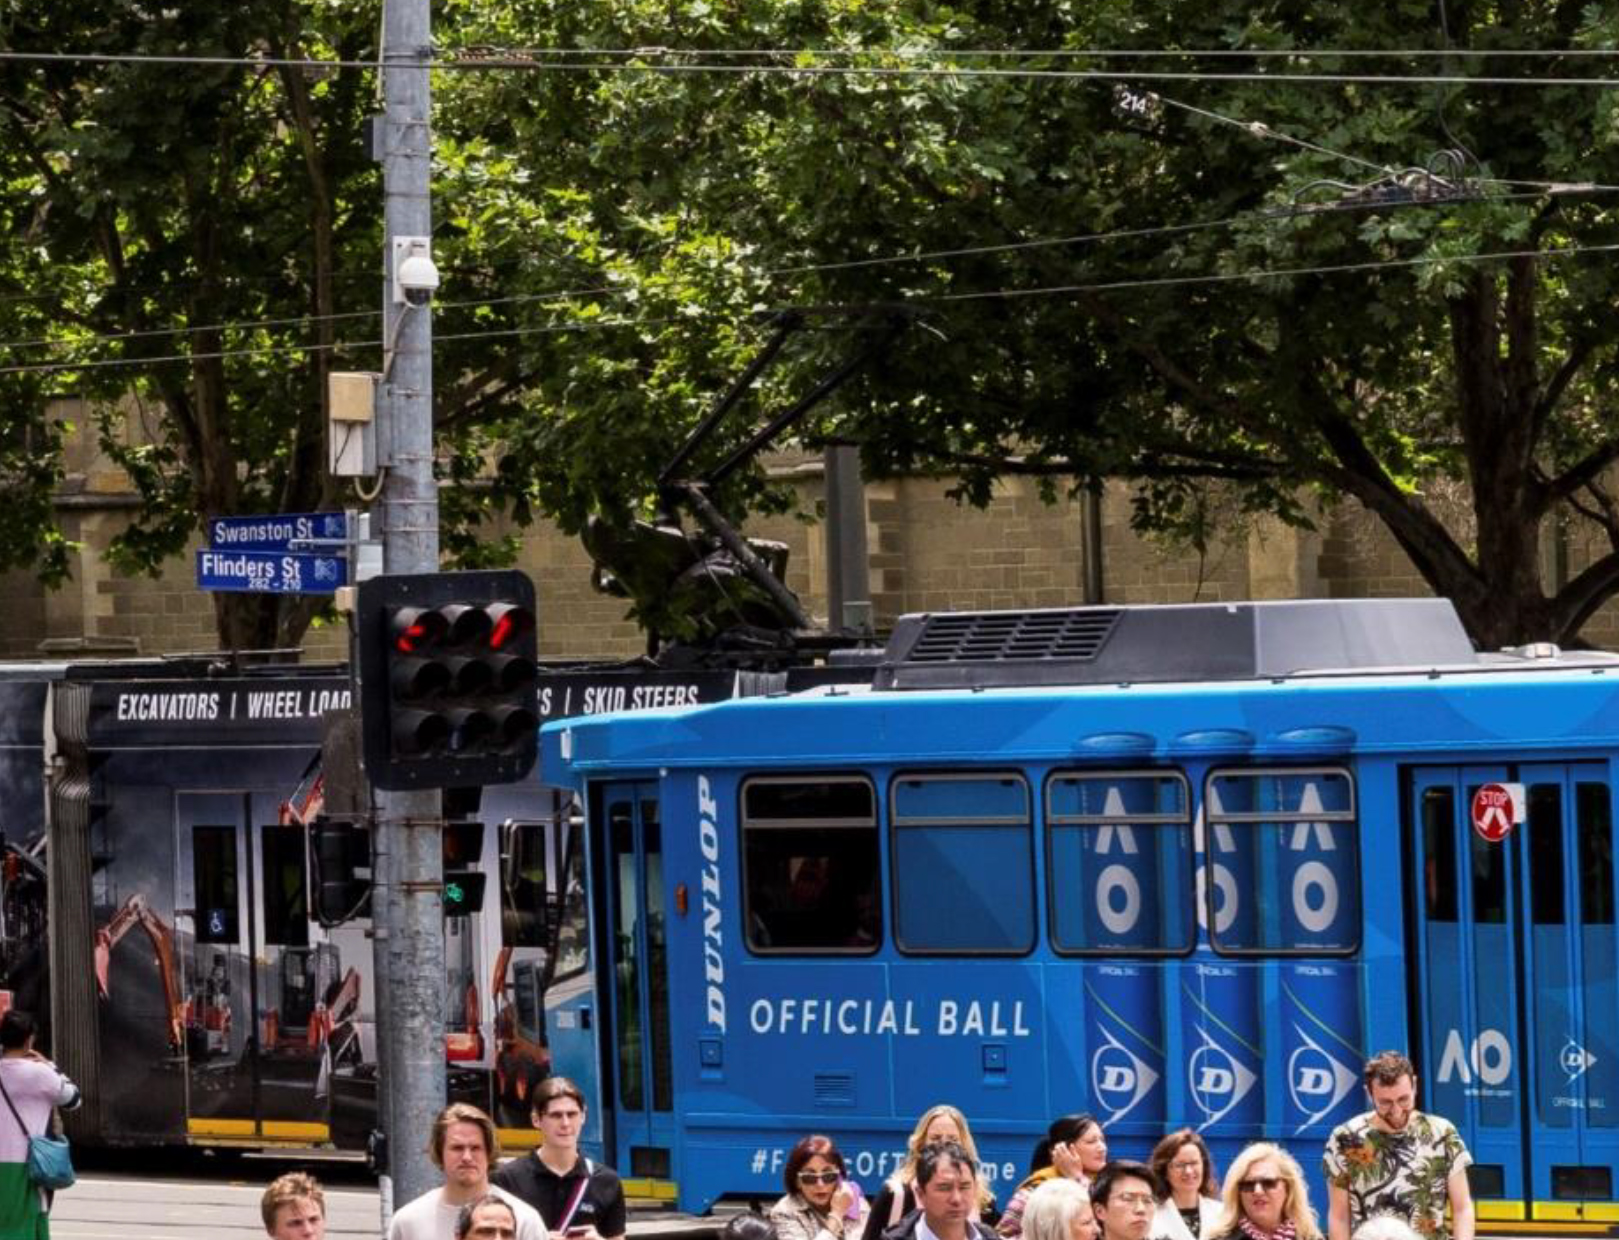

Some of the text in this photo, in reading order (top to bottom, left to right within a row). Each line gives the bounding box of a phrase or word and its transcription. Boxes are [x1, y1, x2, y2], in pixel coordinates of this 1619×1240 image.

[1120, 91, 1147, 113] 214
[215, 518, 313, 543] Swanston St
[202, 553, 301, 579] Flinders St
[118, 693, 220, 721] EXCAVATORS
[248, 691, 303, 719] WHEEL
[583, 687, 626, 715] SKID
[631, 685, 699, 712] STEERS
[1480, 790, 1508, 807] STOP
[698, 774, 727, 1036] DUNLOP
[750, 999, 1030, 1036] OFFICIAL BALL
